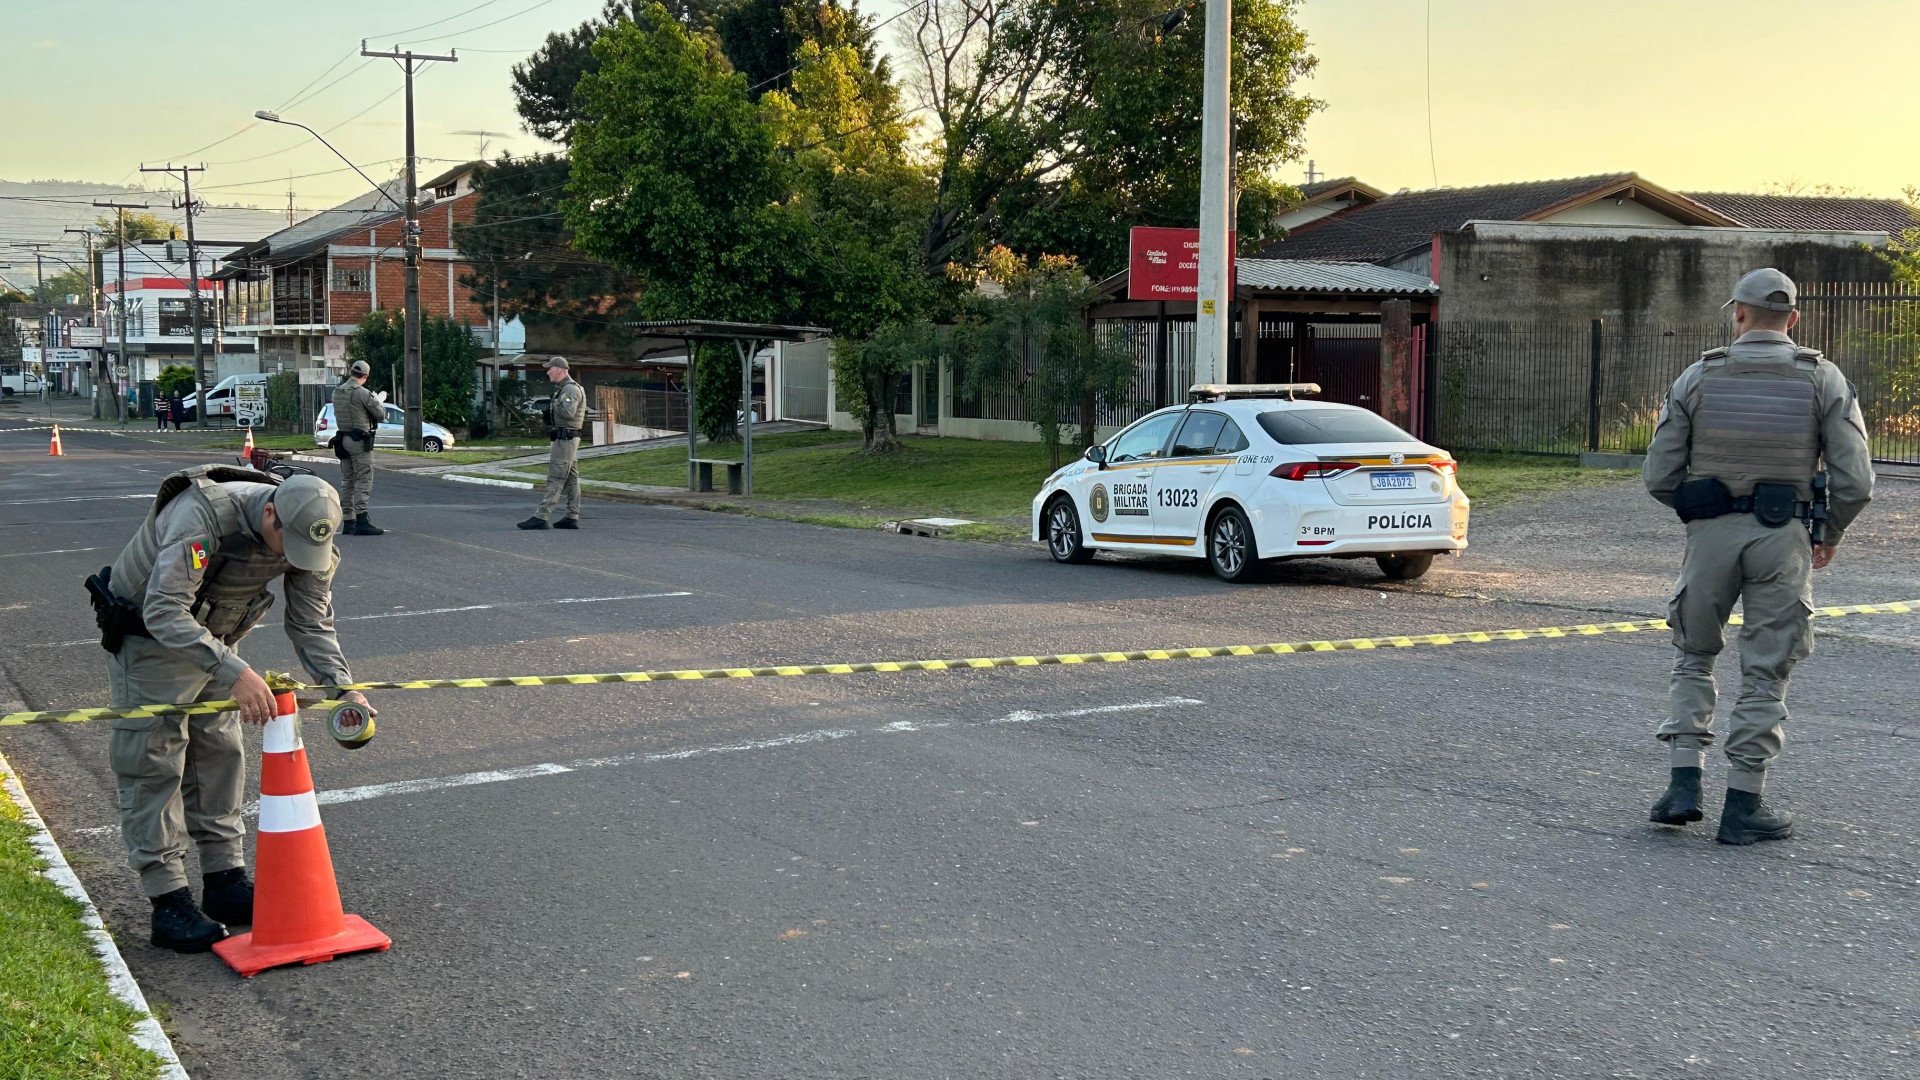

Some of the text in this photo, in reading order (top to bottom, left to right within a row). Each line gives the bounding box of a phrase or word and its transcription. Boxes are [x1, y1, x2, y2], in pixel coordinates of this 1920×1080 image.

[1376, 477, 1413, 488] JBA2D72
[1113, 483, 1148, 495] BRIGADA
[1113, 496, 1148, 507] MILITAR
[1157, 488, 1198, 507] 13023
[1368, 511, 1432, 529] POLÍCIA
[1314, 527, 1335, 535] BPM
